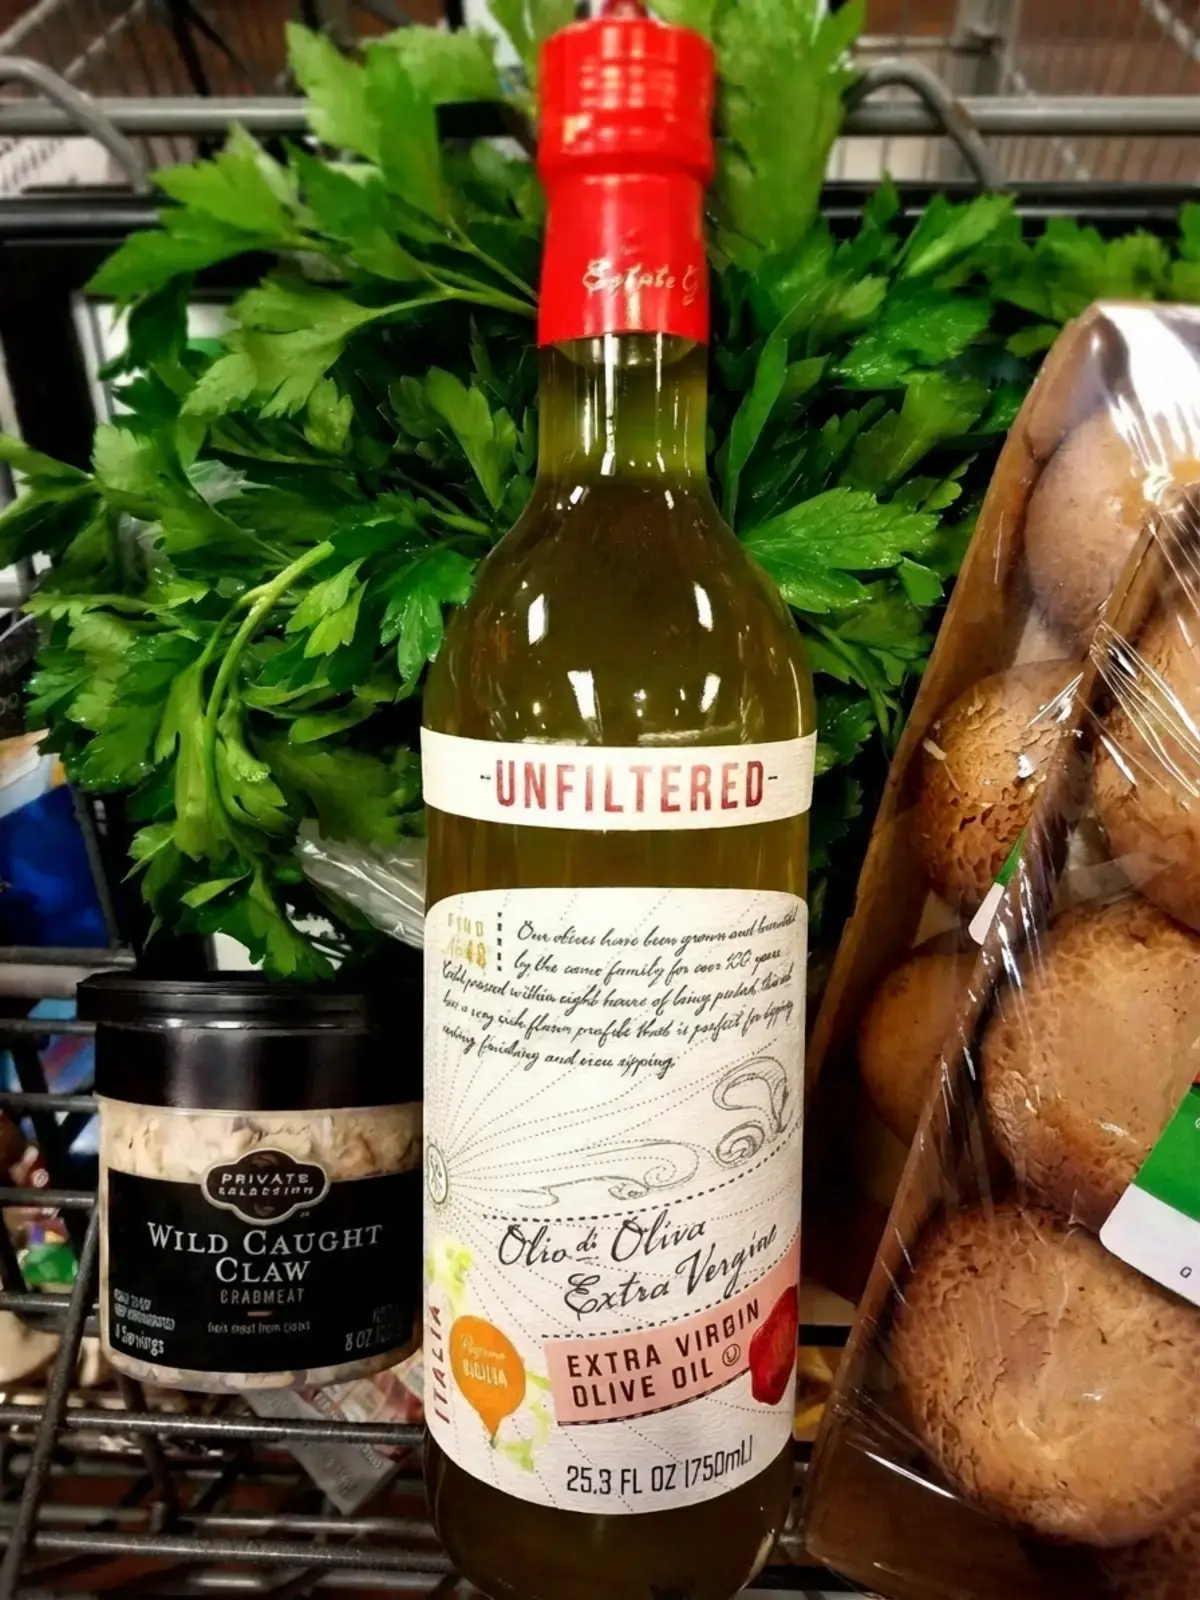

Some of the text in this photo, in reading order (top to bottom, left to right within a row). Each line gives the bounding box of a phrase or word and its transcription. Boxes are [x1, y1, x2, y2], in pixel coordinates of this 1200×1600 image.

[495, 759, 764, 813] UNFILTERED
[517, 920, 549, 941] Our
[644, 926, 677, 947] been
[675, 933, 726, 957] grown
[728, 919, 757, 940] and
[514, 949, 531, 979] by
[534, 954, 558, 974] the
[604, 956, 666, 988] family
[665, 958, 689, 986] for
[651, 988, 674, 1016] of
[741, 1008, 761, 1037] for
[545, 1049, 581, 1065] and
[221, 1172, 310, 1186] PRIVATE
[147, 1221, 383, 1256] WILD CAUGHT
[499, 1209, 706, 1266] Olio di Oliva
[215, 1256, 312, 1283] CLAW
[219, 1287, 305, 1305] CRABMEAT
[564, 1272, 669, 1322] Extra
[566, 1298, 760, 1379] EXTRA VIRGIN
[428, 1305, 451, 1425] ITALIA
[572, 1357, 714, 1408] OLIVE OIL
[567, 1465, 612, 1495] 25.3
[620, 1468, 643, 1495] FL
[651, 1463, 677, 1491] OZ
